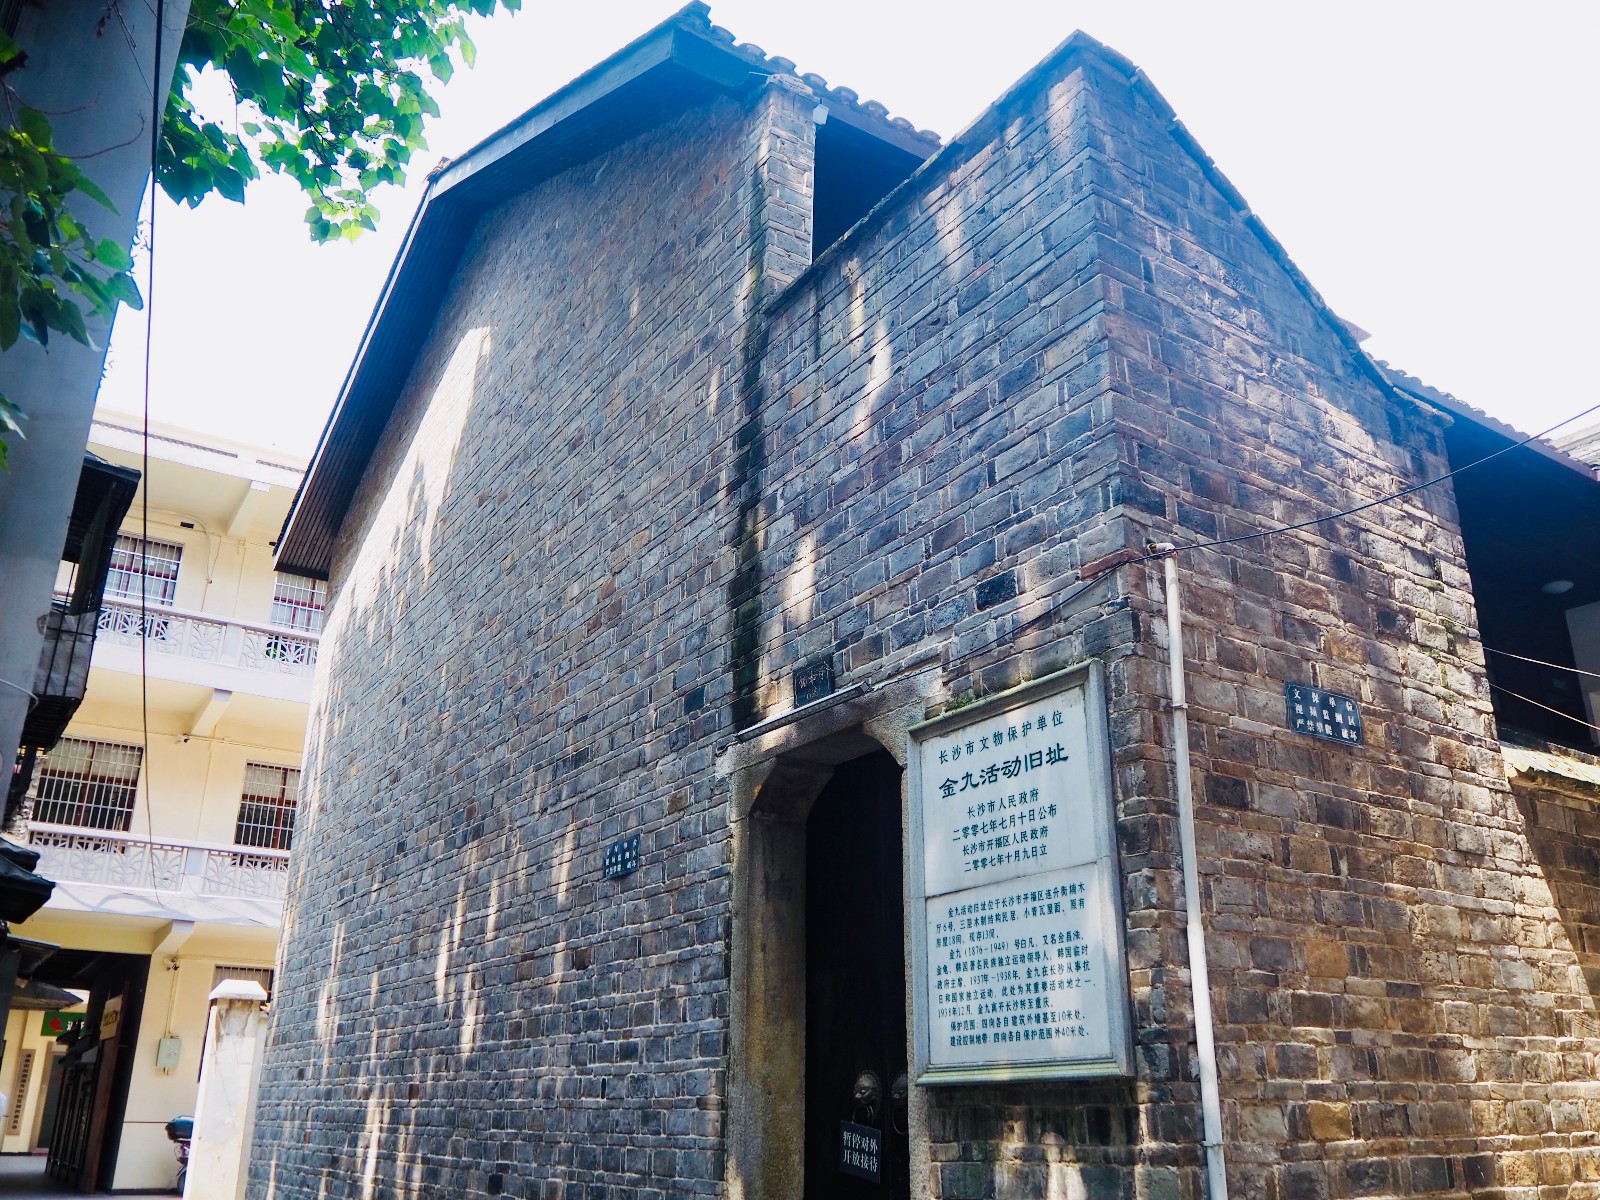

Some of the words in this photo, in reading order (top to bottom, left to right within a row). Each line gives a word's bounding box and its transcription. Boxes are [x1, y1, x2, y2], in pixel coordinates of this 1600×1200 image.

[1293, 689, 1353, 711] 文保单位
[938, 710, 1063, 765] 长沙市文物保护单位
[939, 743, 1068, 799] 金九活动旧址
[967, 788, 1039, 819] 长沙市人民政府
[953, 804, 1057, 842] 二零零七年七月十日公布
[962, 826, 1049, 856] 长沙市开福区人民政府
[965, 843, 1048, 872] 二零零七年十月九日立
[843, 1131, 878, 1155] 暂停对外
[843, 1149, 878, 1173] 开放接待
